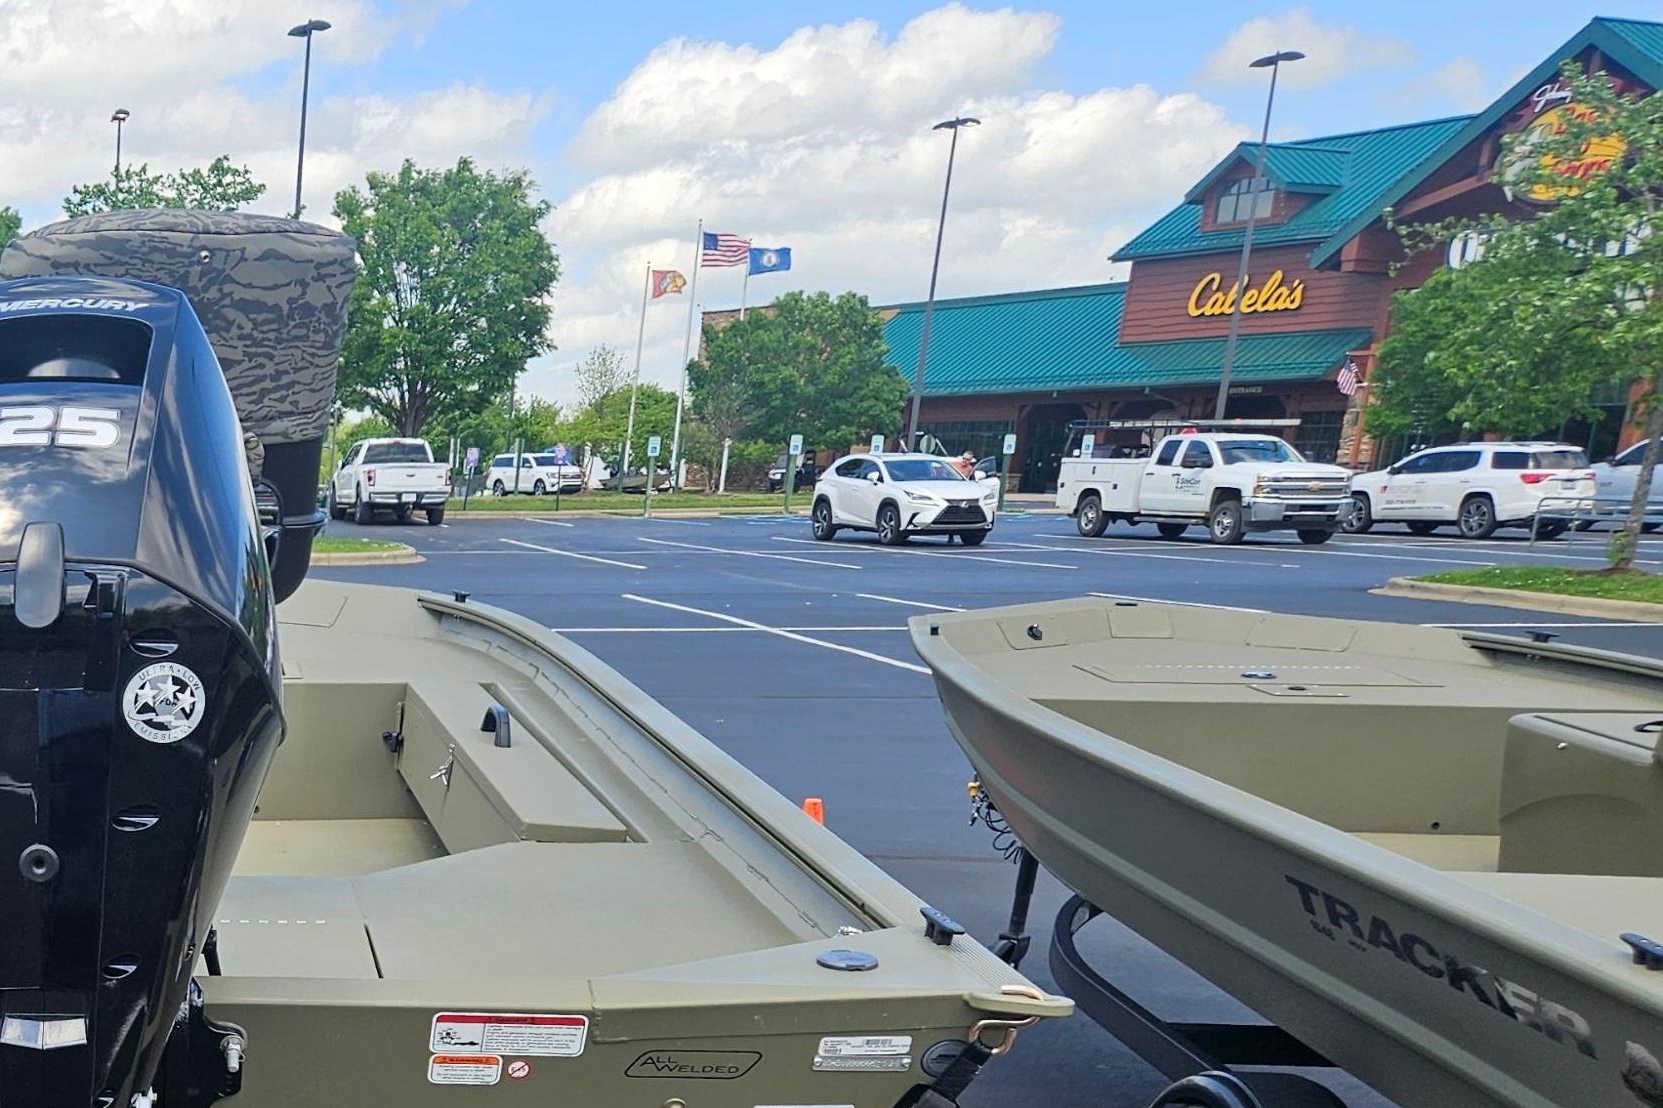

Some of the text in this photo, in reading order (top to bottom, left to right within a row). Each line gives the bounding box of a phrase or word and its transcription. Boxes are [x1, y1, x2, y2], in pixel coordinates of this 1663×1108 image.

[1187, 269, 1305, 317] Cabela's
[138, 665, 201, 690] ULTRA LOW
[1284, 874, 1599, 1061] TRACKER
[640, 1055, 678, 1068] ALL
[654, 1063, 740, 1074] WELDED
